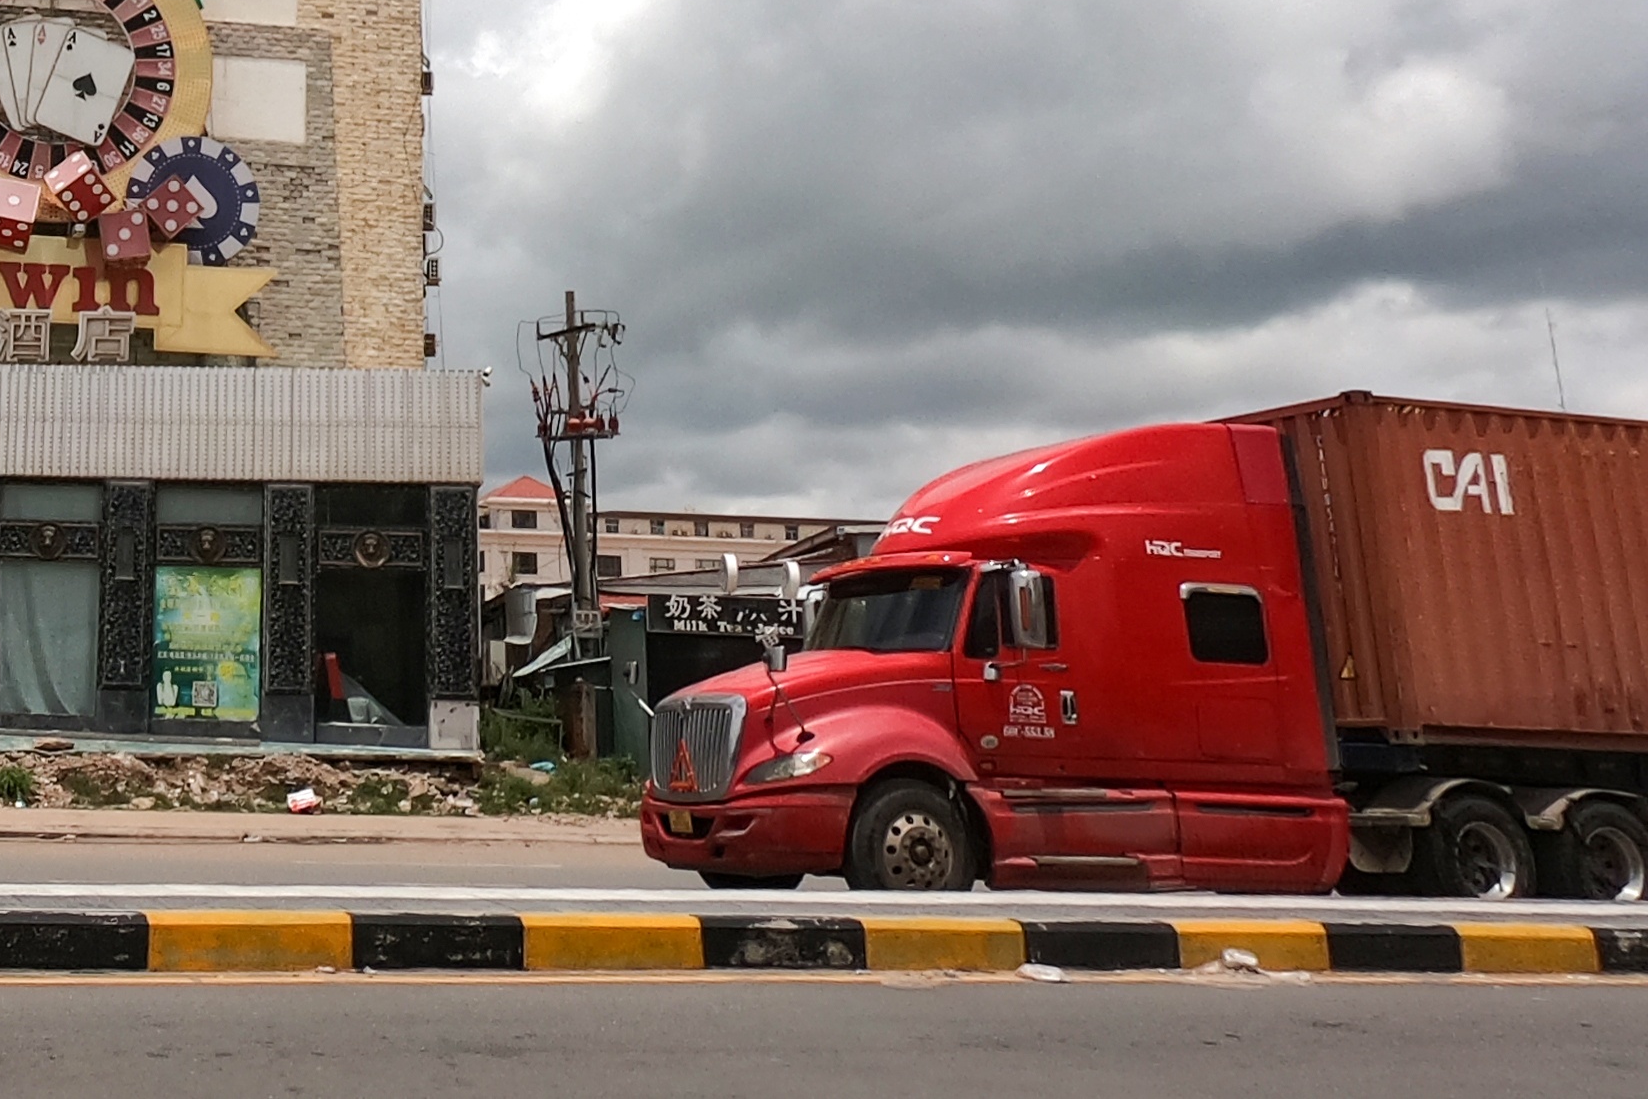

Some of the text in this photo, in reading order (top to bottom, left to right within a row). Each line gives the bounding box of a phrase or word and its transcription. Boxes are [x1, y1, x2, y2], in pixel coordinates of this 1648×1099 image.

[142, 9, 157, 21] 2
[150, 24, 168, 40] 25
[155, 43, 171, 57] 17
[142, 112, 159, 129] 13
[119, 141, 135, 157] 11
[12, 159, 29, 176] 24
[1423, 449, 1515, 515] CAI
[673, 619, 709, 633] Milk
[717, 620, 743, 634] Tea
